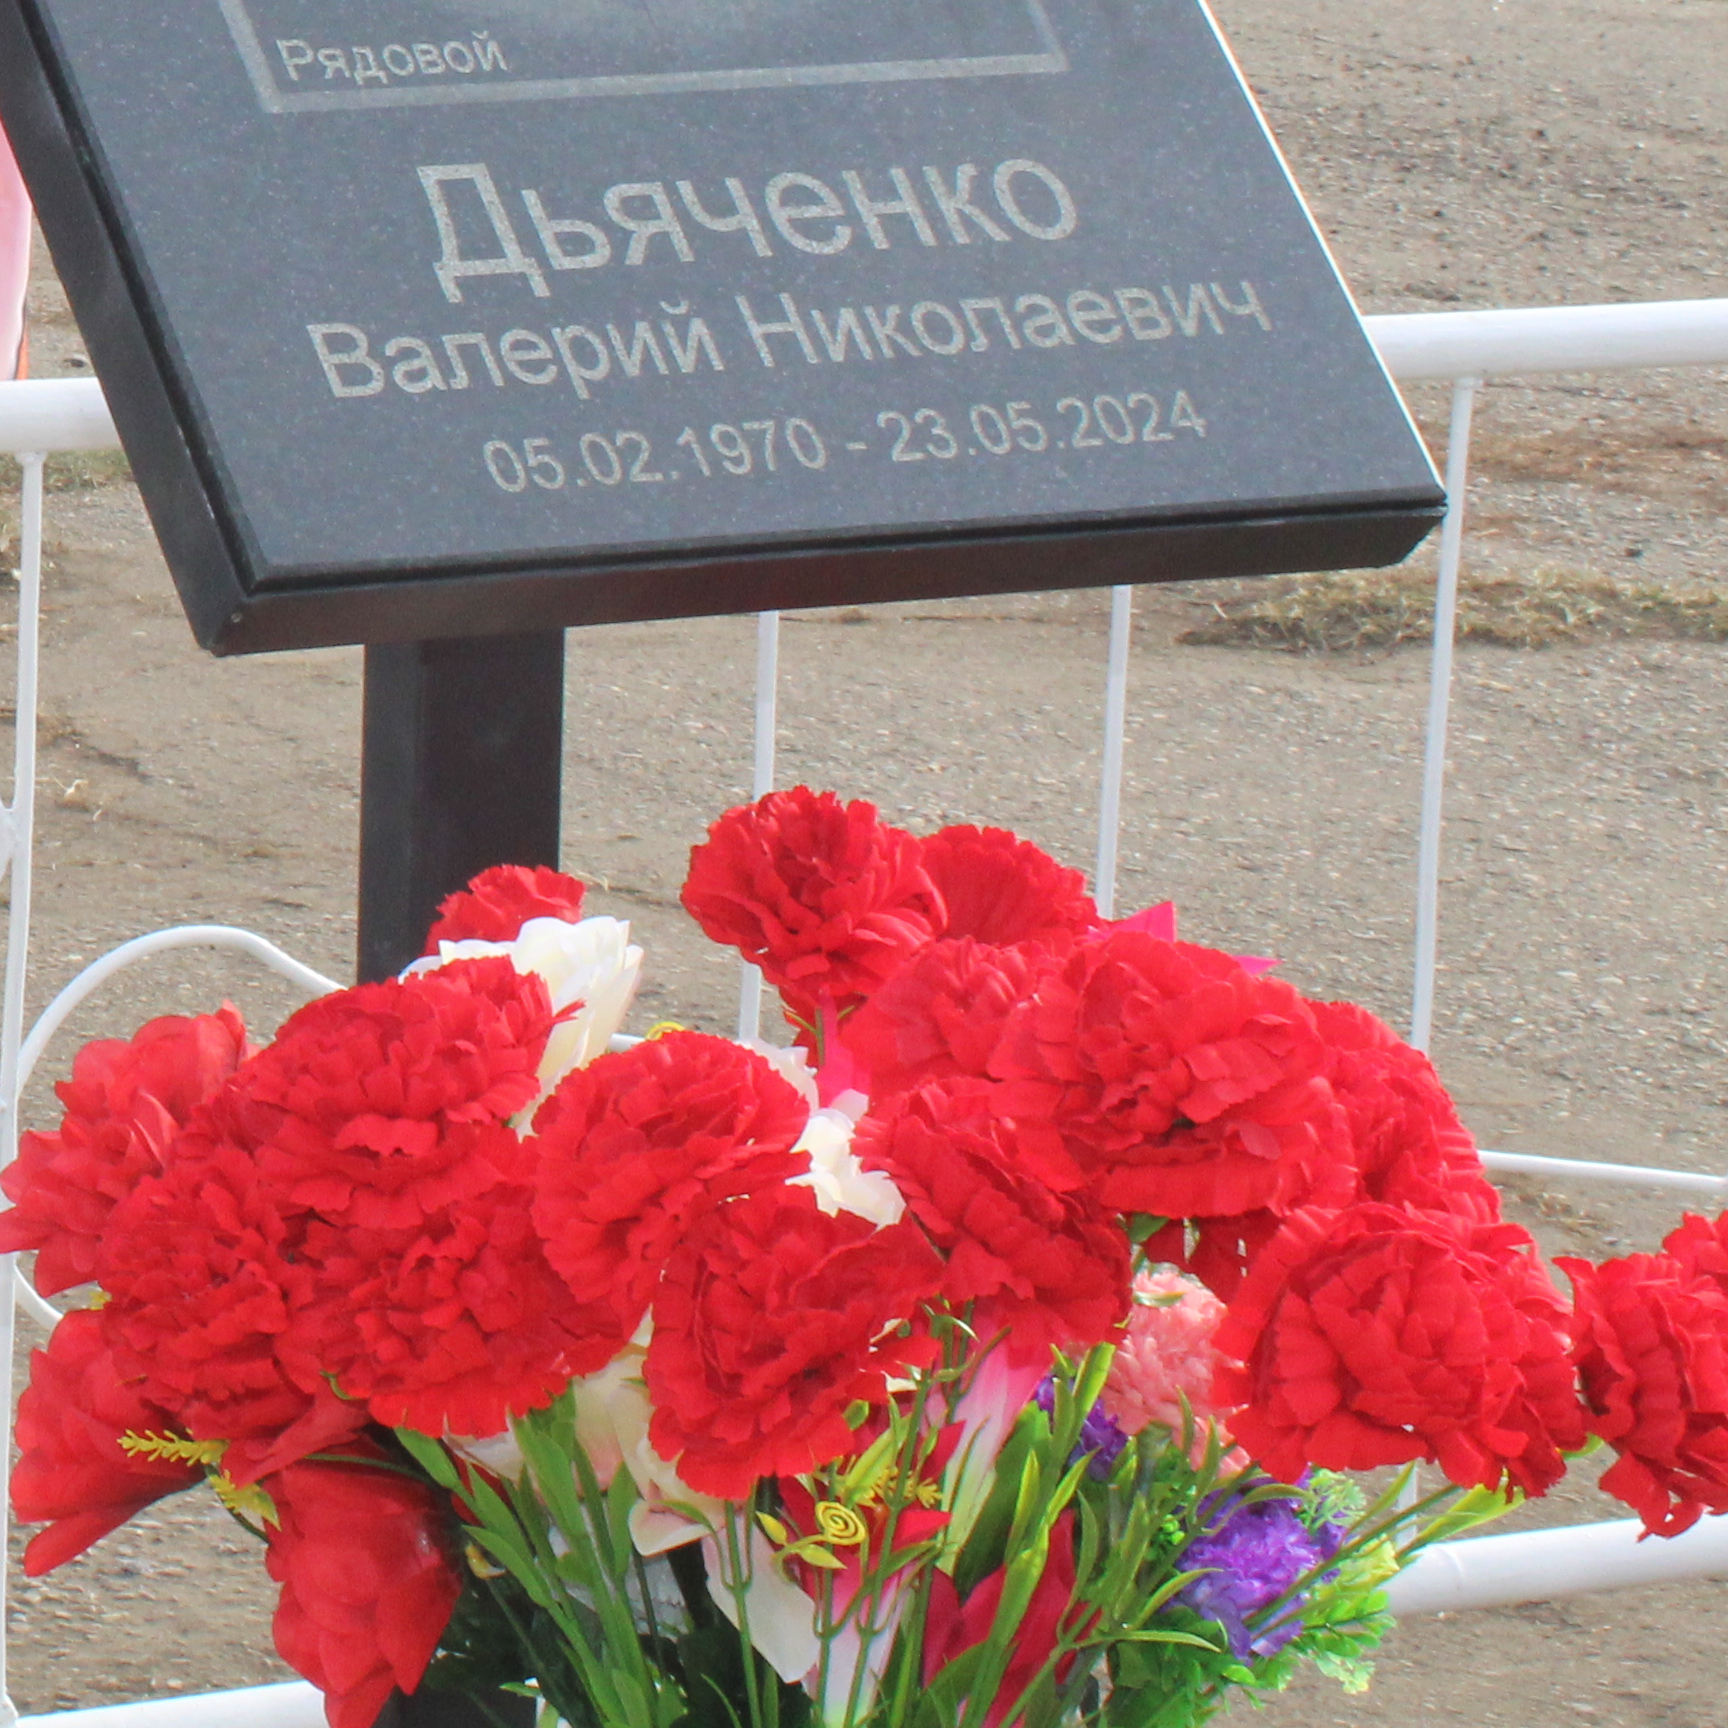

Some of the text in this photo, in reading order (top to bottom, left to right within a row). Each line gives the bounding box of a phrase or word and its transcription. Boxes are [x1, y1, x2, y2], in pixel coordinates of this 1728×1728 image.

[276, 30, 508, 84] Рядовой
[417, 158, 1077, 303] Дьяченко
[306, 281, 1270, 399] Валерий Николаевич
[484, 417, 826, 492] 05.02.1970
[877, 390, 1206, 462] 23.05.2024
